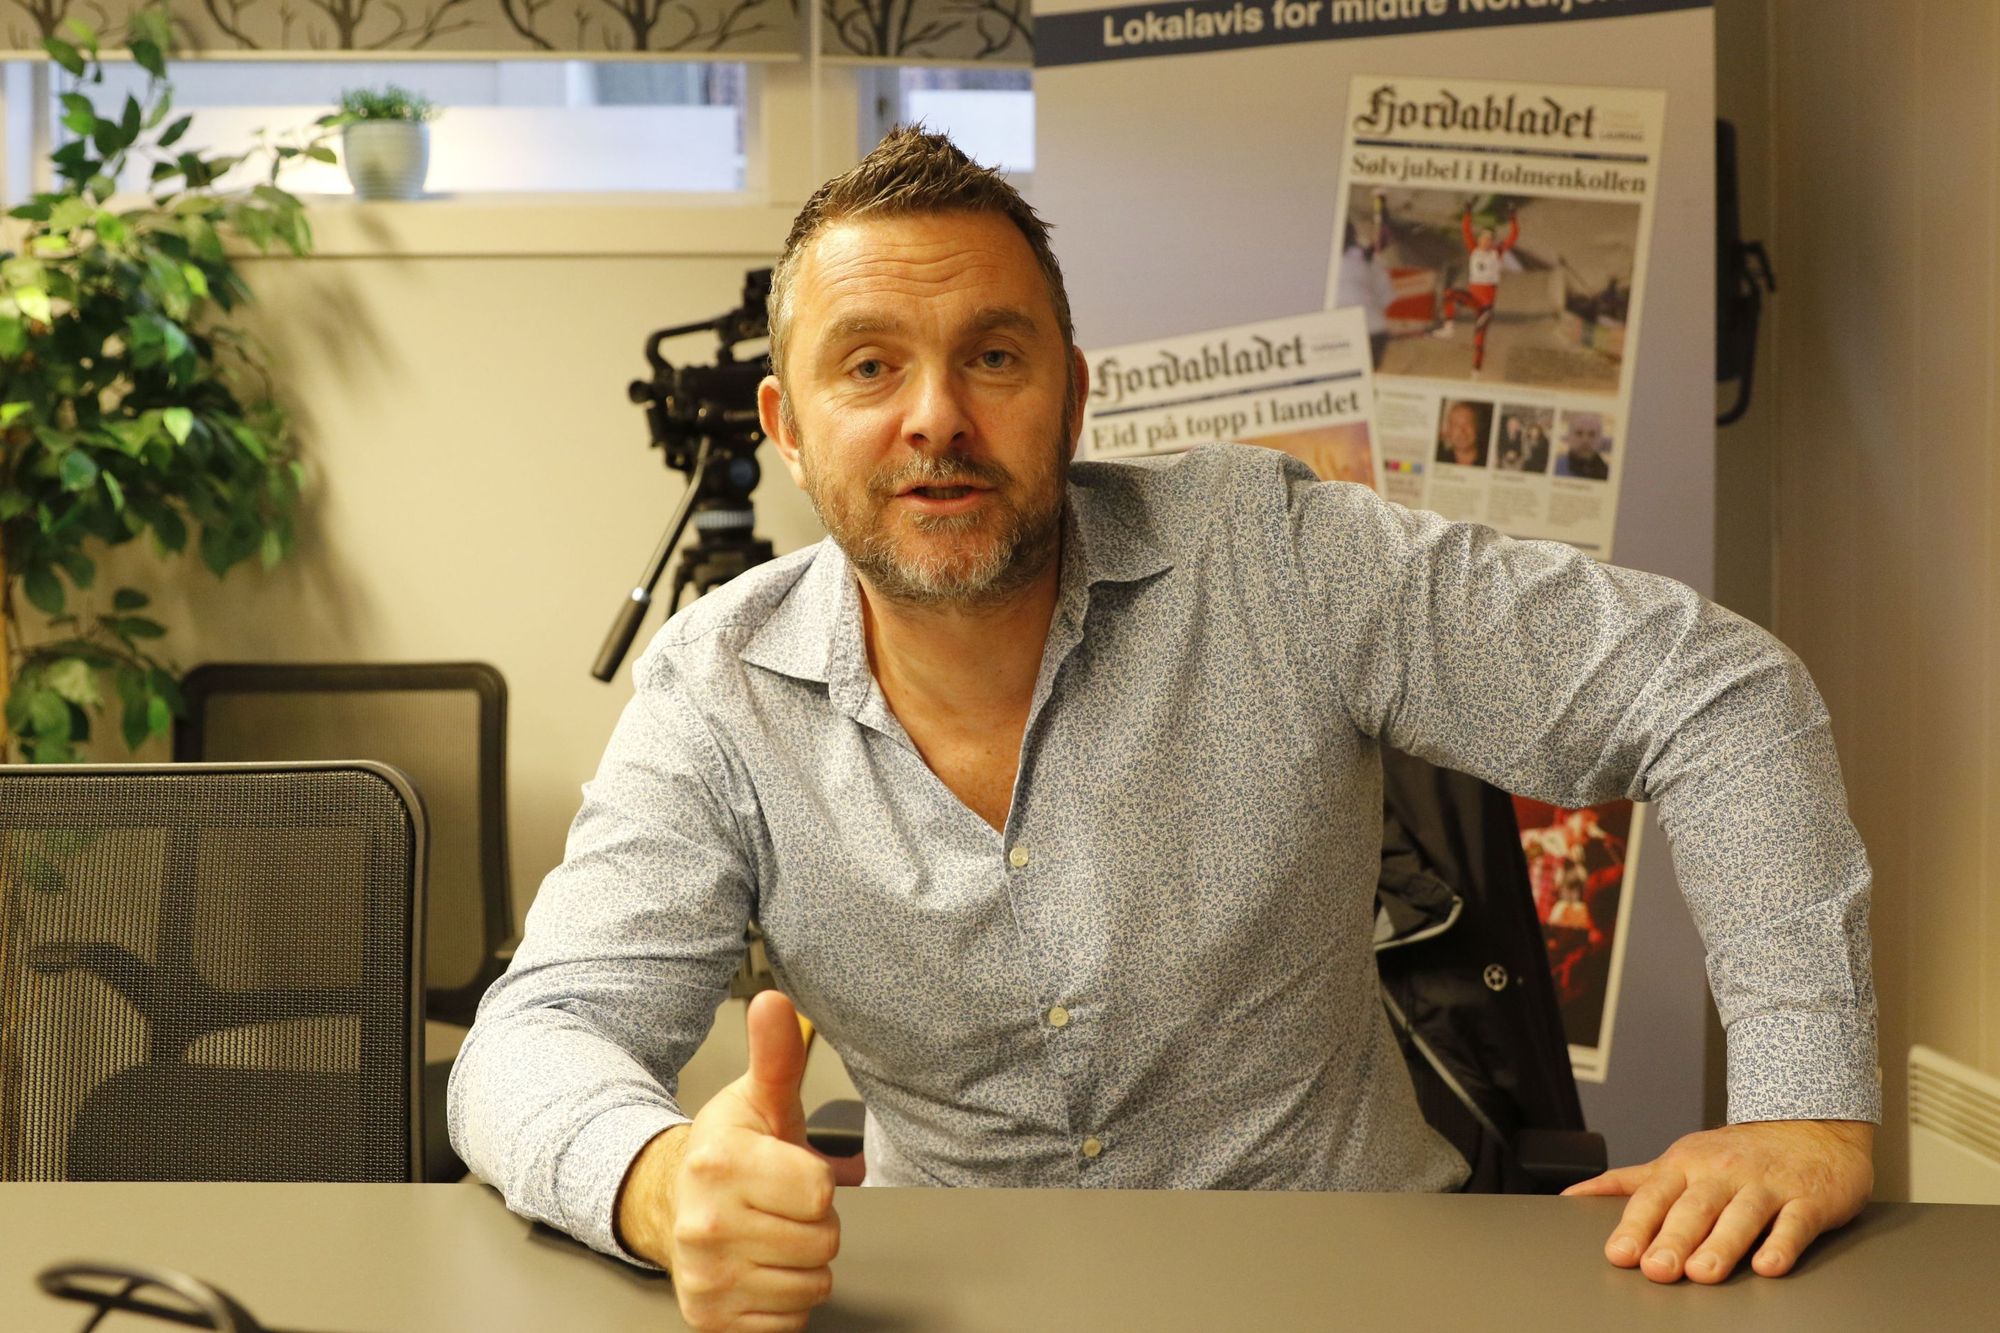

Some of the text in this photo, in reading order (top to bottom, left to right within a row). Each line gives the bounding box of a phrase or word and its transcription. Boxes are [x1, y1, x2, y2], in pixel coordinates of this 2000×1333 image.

[1102, 3, 1264, 47] Lokalavis
[1272, 0, 1324, 30] for
[1355, 85, 1595, 140] Fjordabladet
[1464, 159, 1475, 180] i
[1480, 161, 1647, 194] Holmenkollen
[1089, 334, 1306, 404] Fjordabladet
[1092, 422, 1138, 451] Eid
[1145, 415, 1179, 449] på
[1186, 409, 1247, 441] topp
[1253, 402, 1265, 426] i
[1269, 388, 1361, 424] landet
